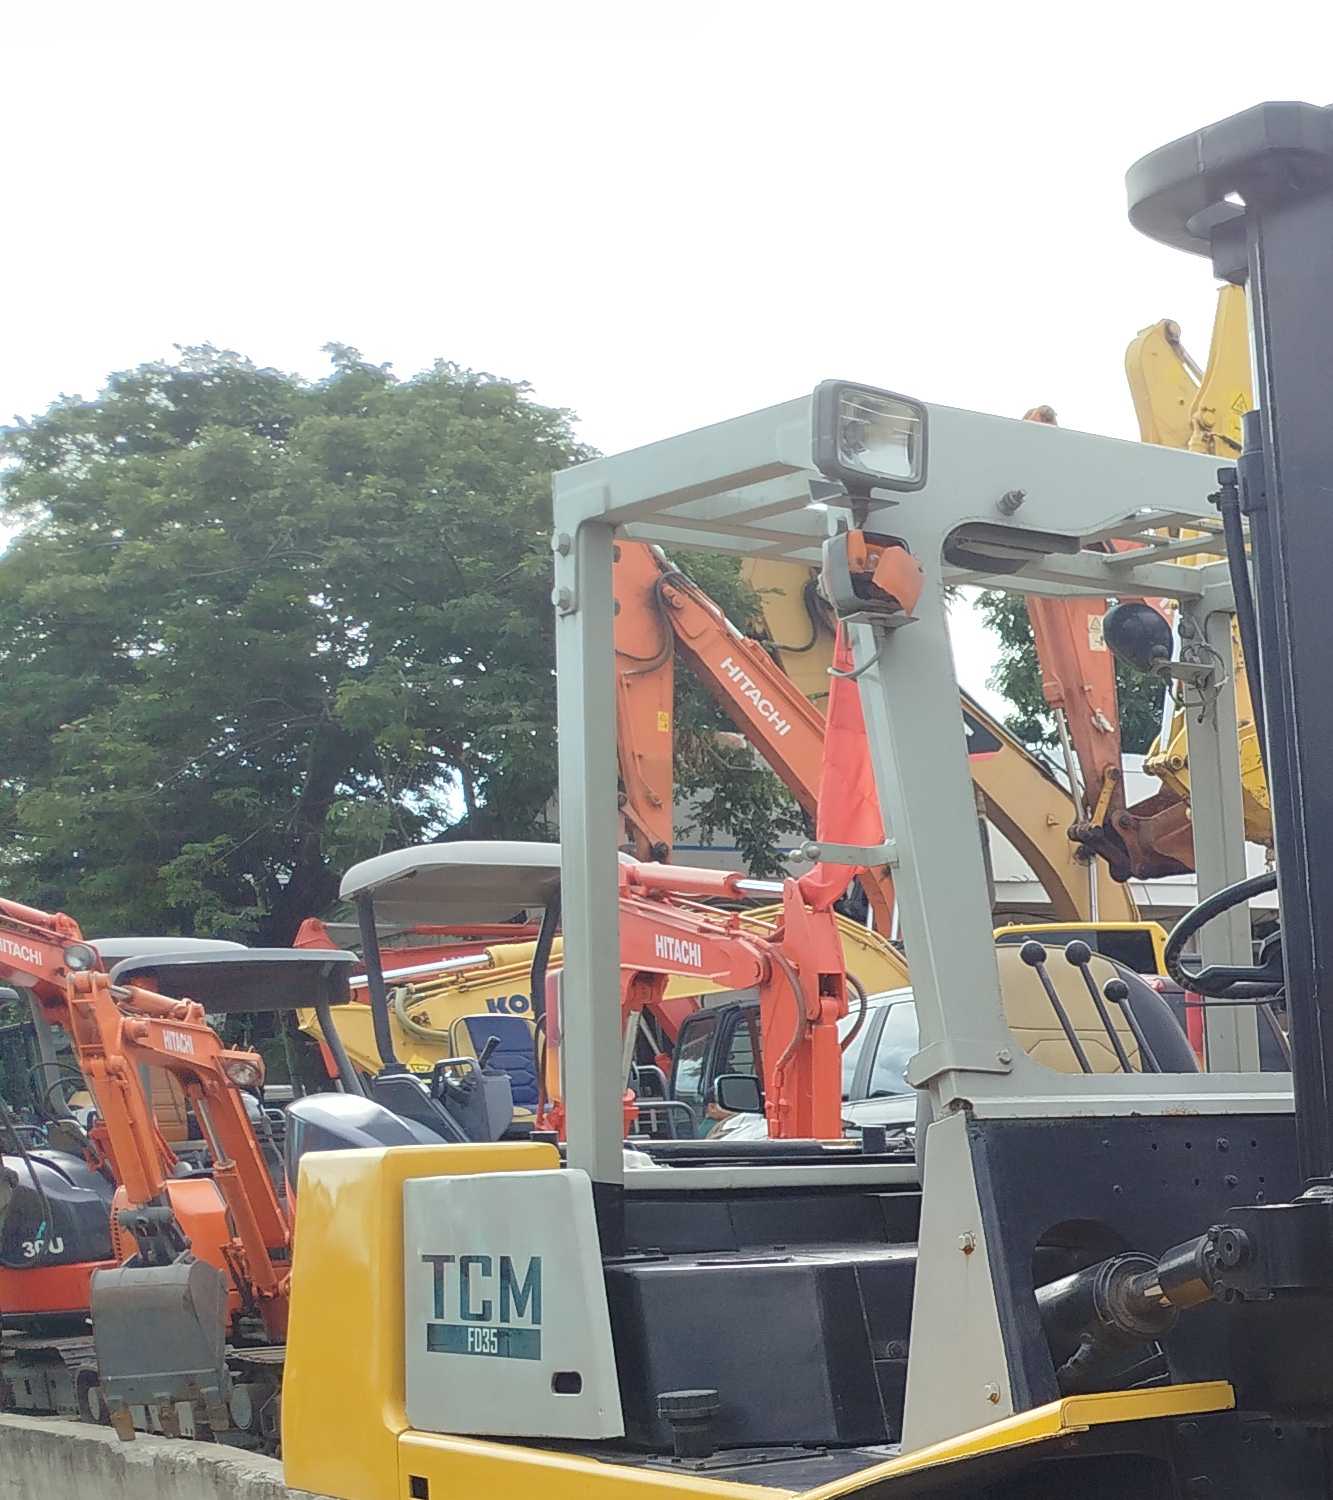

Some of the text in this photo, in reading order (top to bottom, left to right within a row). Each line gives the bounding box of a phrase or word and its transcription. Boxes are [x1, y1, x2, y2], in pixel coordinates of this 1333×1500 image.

[720, 657, 792, 736] HITACHI
[655, 934, 702, 967] HITACHI
[162, 1029, 195, 1055] HITACHI
[421, 1254, 542, 1325] TCM
[467, 1327, 498, 1354] FD35
